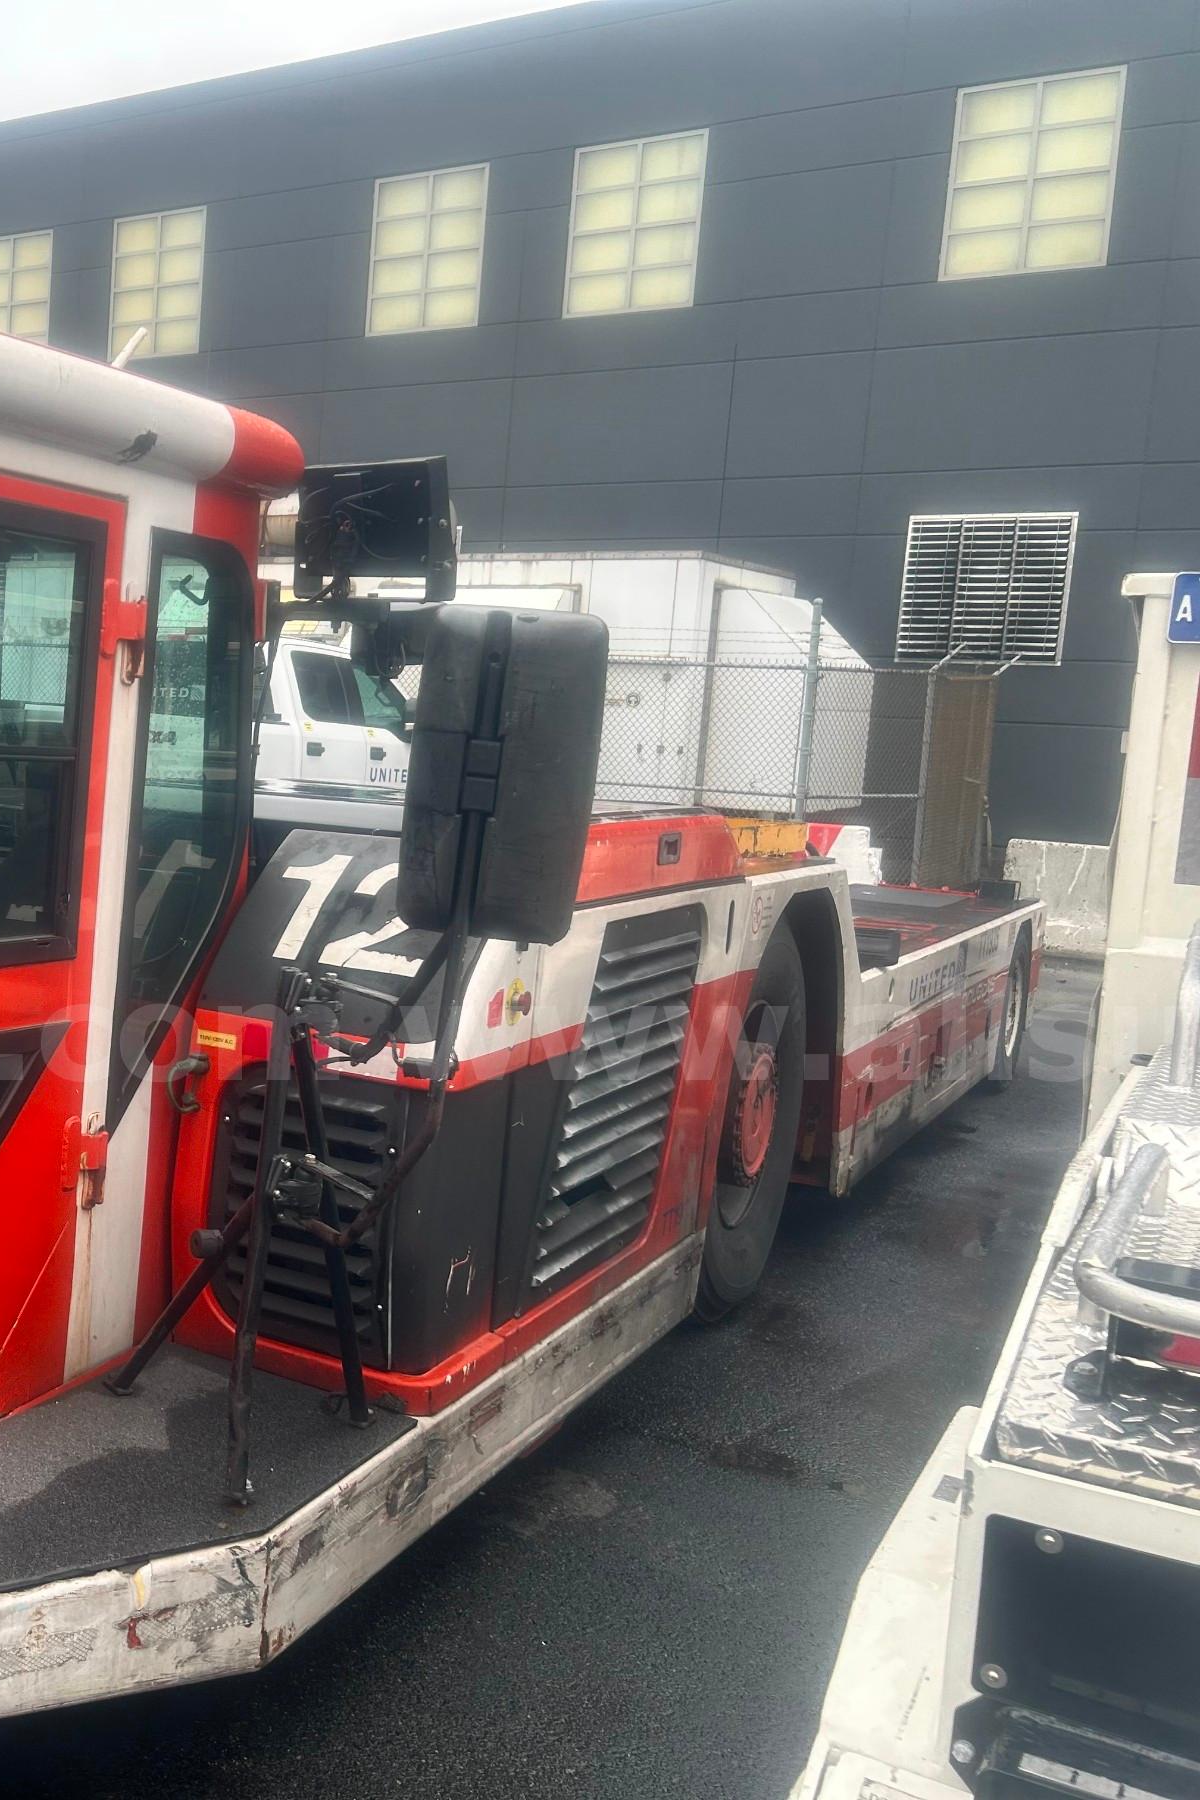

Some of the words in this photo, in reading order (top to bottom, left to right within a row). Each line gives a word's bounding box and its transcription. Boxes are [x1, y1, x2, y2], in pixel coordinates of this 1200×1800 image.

[152, 687, 189, 698] ITED
[369, 767, 408, 783] UNITE
[909, 961, 957, 1004] UNITED
